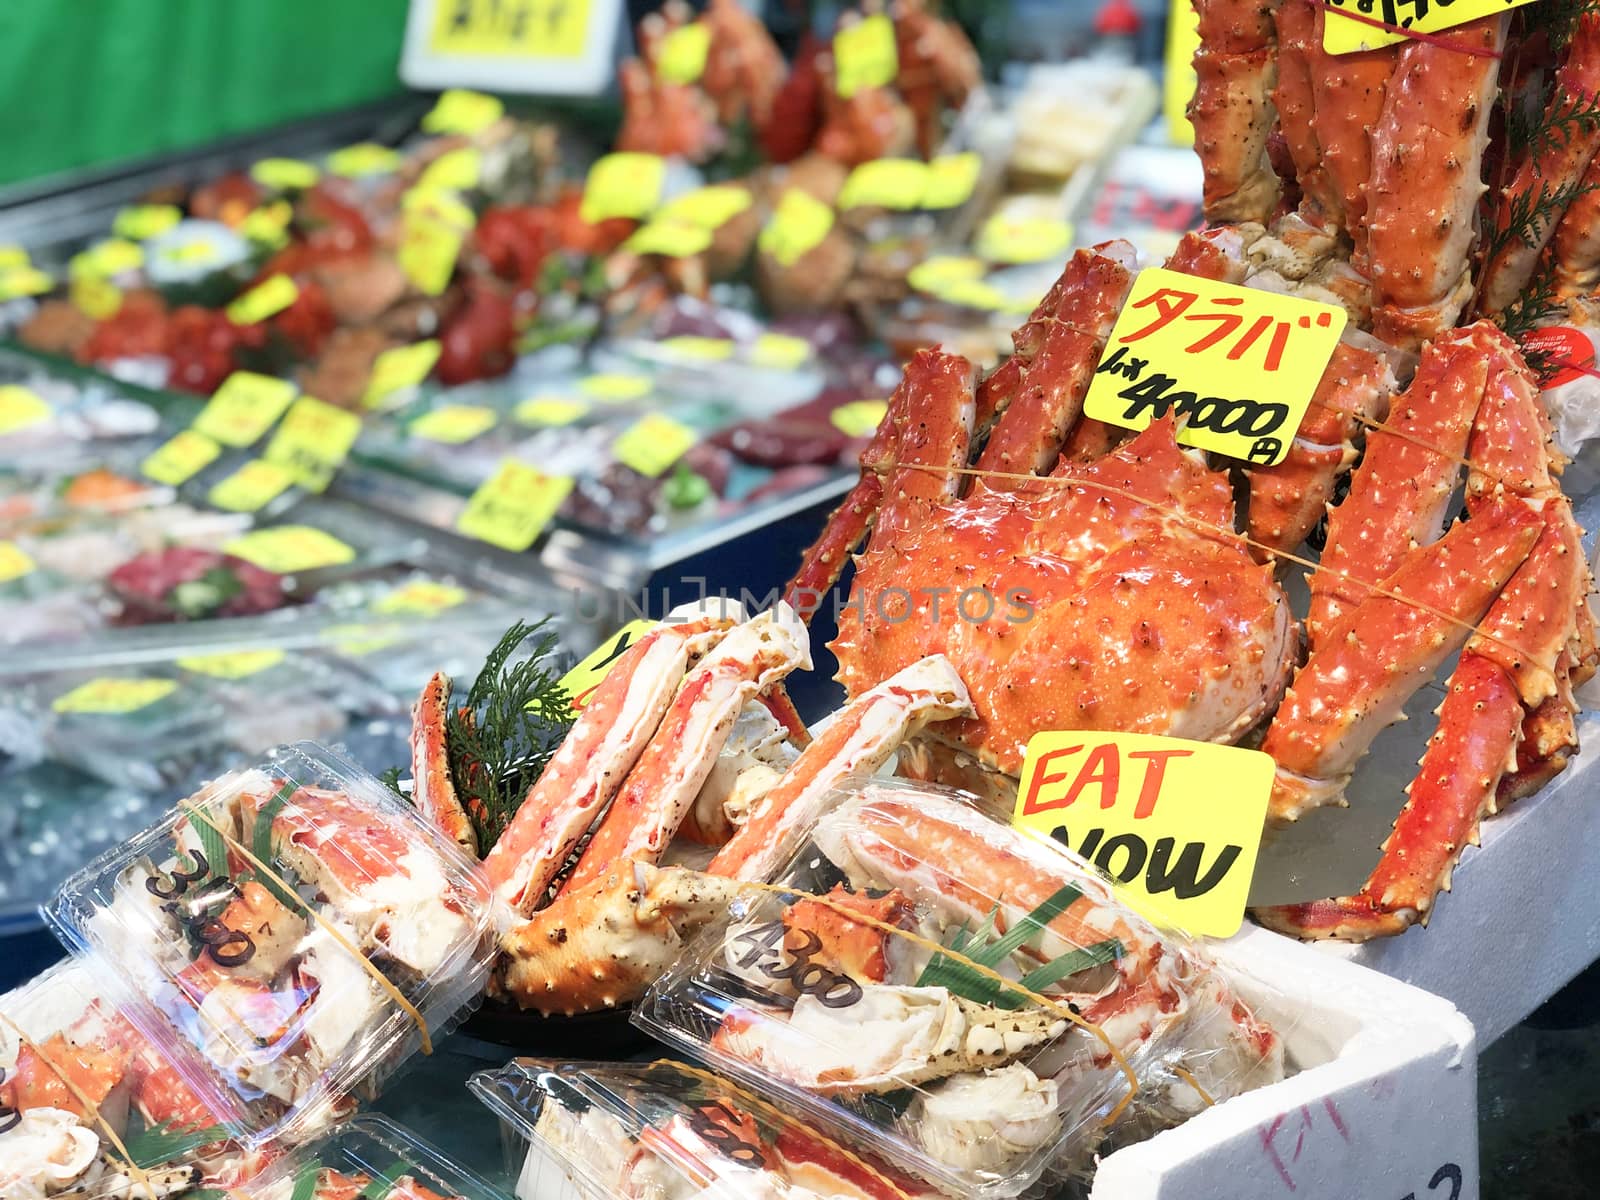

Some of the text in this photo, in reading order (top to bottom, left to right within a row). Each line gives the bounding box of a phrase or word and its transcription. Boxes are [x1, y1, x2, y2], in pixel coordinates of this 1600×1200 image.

[1118, 287, 1332, 371] タラバ
[1022, 742, 1195, 819] EAT
